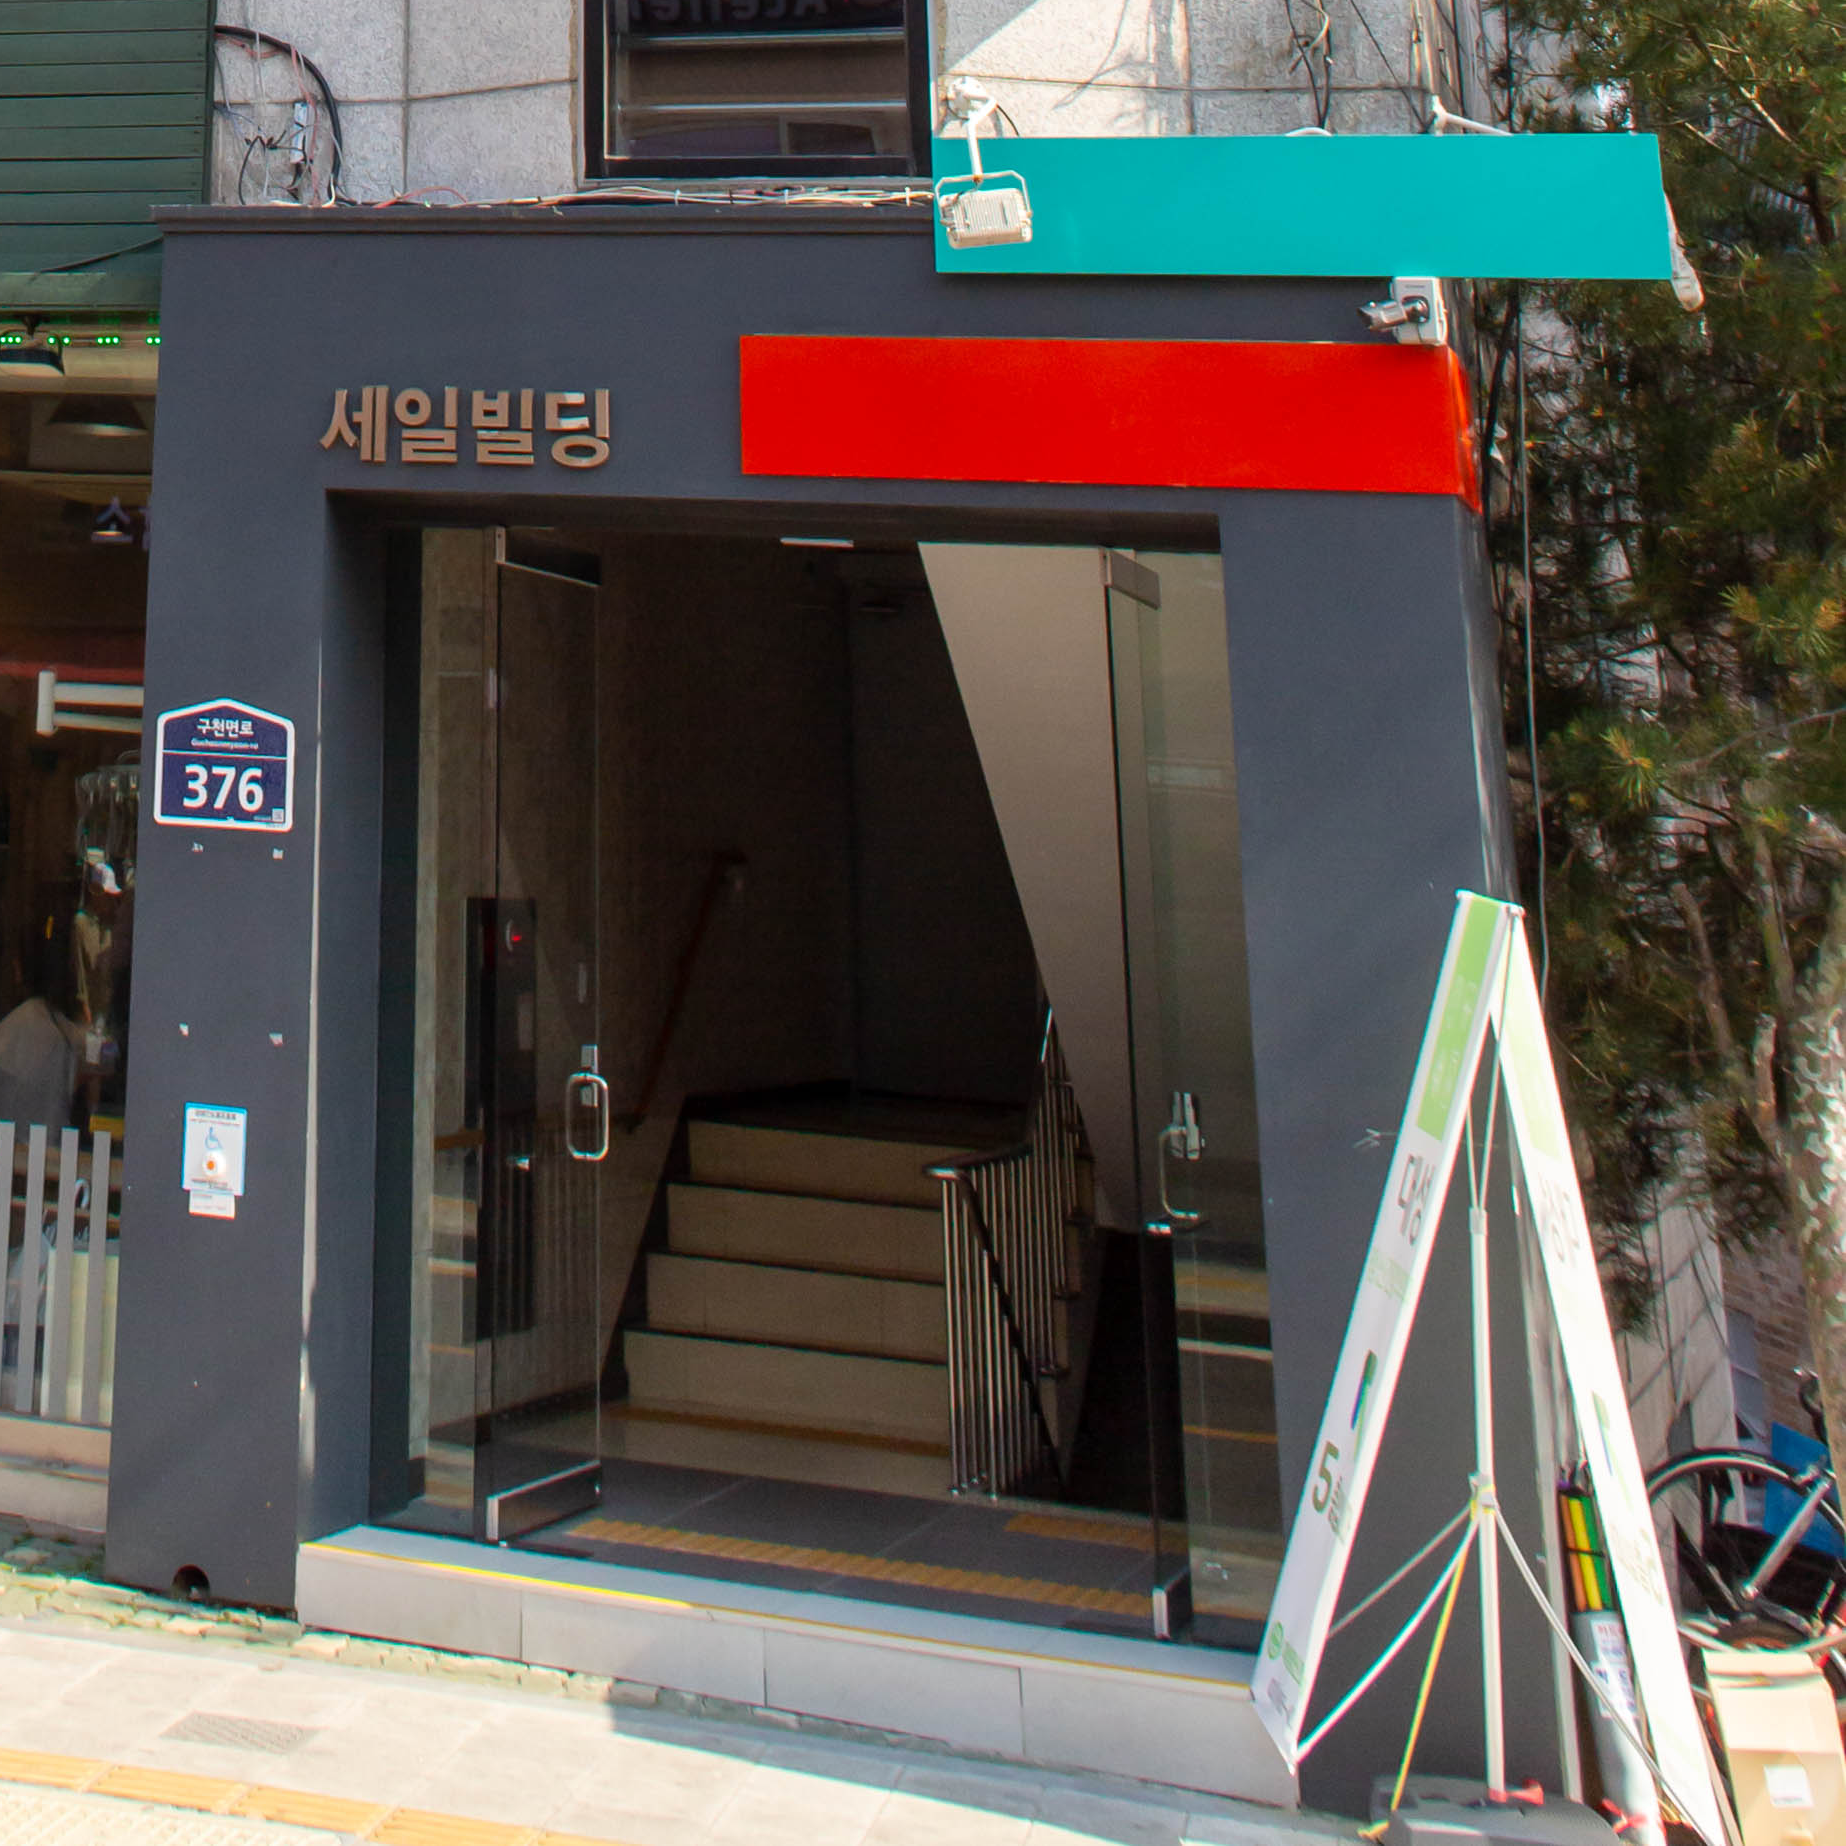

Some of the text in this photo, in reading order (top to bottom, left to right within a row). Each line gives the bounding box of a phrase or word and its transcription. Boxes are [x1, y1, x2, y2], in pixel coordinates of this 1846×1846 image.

[318, 383, 612, 469] 세일빌딩
[196, 717, 255, 738] 구천면로
[182, 763, 264, 814] 376
